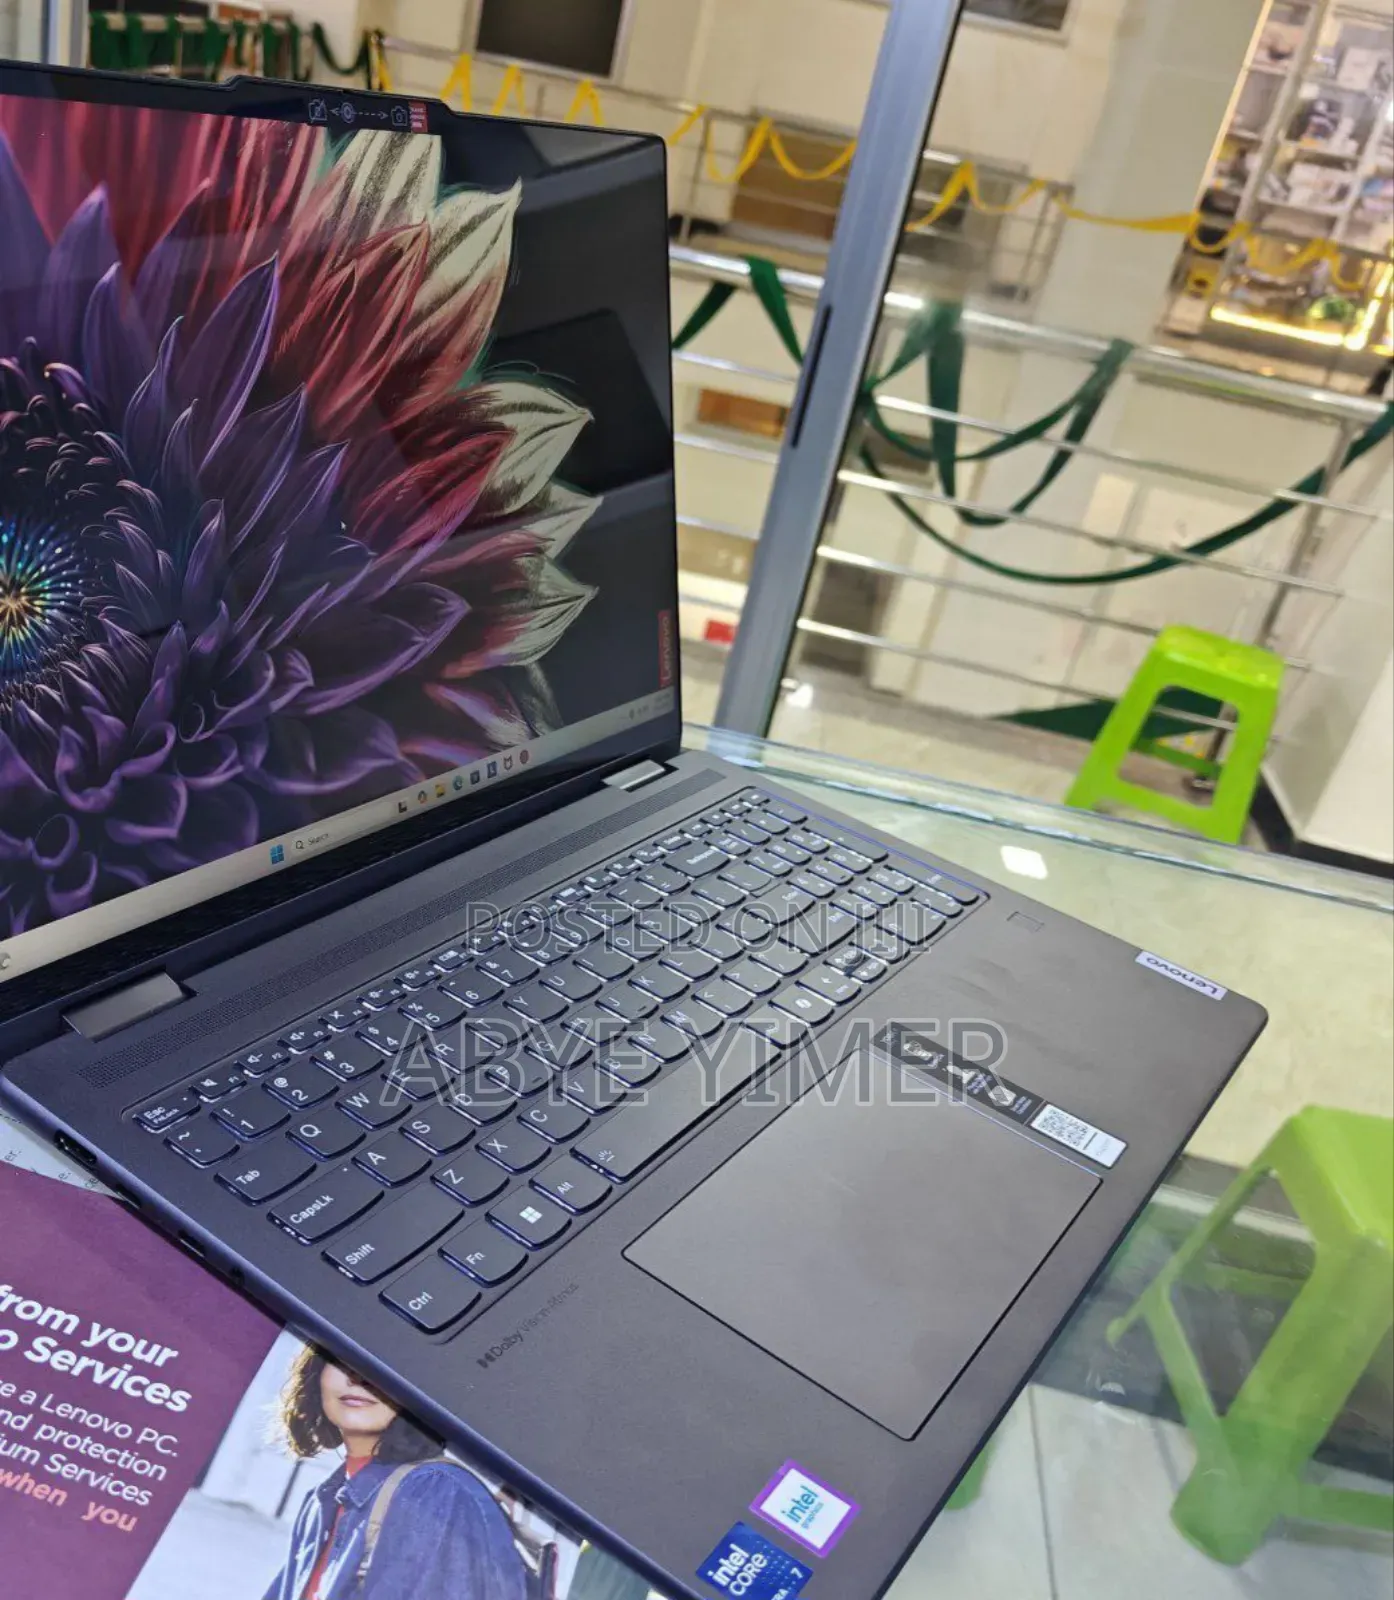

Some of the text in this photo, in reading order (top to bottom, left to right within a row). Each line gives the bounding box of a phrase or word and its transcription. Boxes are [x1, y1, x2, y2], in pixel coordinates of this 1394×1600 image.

[501, 968, 515, 980] 7
[549, 975, 566, 987] U
[638, 975, 655, 987] K
[1146, 957, 1218, 995] Lenovo
[465, 989, 479, 1000] 6
[513, 994, 530, 1007] Y
[426, 1012, 441, 1024] 5
[386, 1036, 400, 1047] 4
[433, 1042, 455, 1057] R
[339, 1062, 355, 1074] 3
[273, 1077, 289, 1088] @
[567, 1081, 585, 1095] V
[291, 1089, 309, 1102] 2
[345, 1091, 371, 1108] W
[454, 1093, 473, 1106] D
[143, 1106, 167, 1119] Esc
[530, 1109, 548, 1123] C
[240, 1119, 255, 1130] 1
[299, 1123, 322, 1139] Q
[411, 1120, 431, 1135] S
[487, 1137, 509, 1153] X
[366, 1151, 388, 1166] A
[235, 1168, 260, 1186] Tab
[442, 1168, 465, 1186] Z
[556, 1180, 574, 1195] Alt
[289, 1193, 335, 1225] CapsLk
[344, 1242, 376, 1266] Shift
[465, 1250, 486, 1265] Fn
[407, 1291, 433, 1311] Ctrl
[80, 1321, 179, 1367] your
[488, 1328, 524, 1358] Dolby
[23, 1336, 193, 1412] Services
[19, 1388, 37, 1406] a
[40, 1393, 133, 1440] Lenovo
[136, 1427, 178, 1458] PC.
[33, 1423, 167, 1482] protection
[44, 1453, 153, 1507] Services
[0, 1468, 138, 1532] when you
[780, 1484, 818, 1523] intel
[707, 1543, 750, 1587] intel
[729, 1553, 768, 1597] CORE
[789, 1566, 804, 1580] 7
